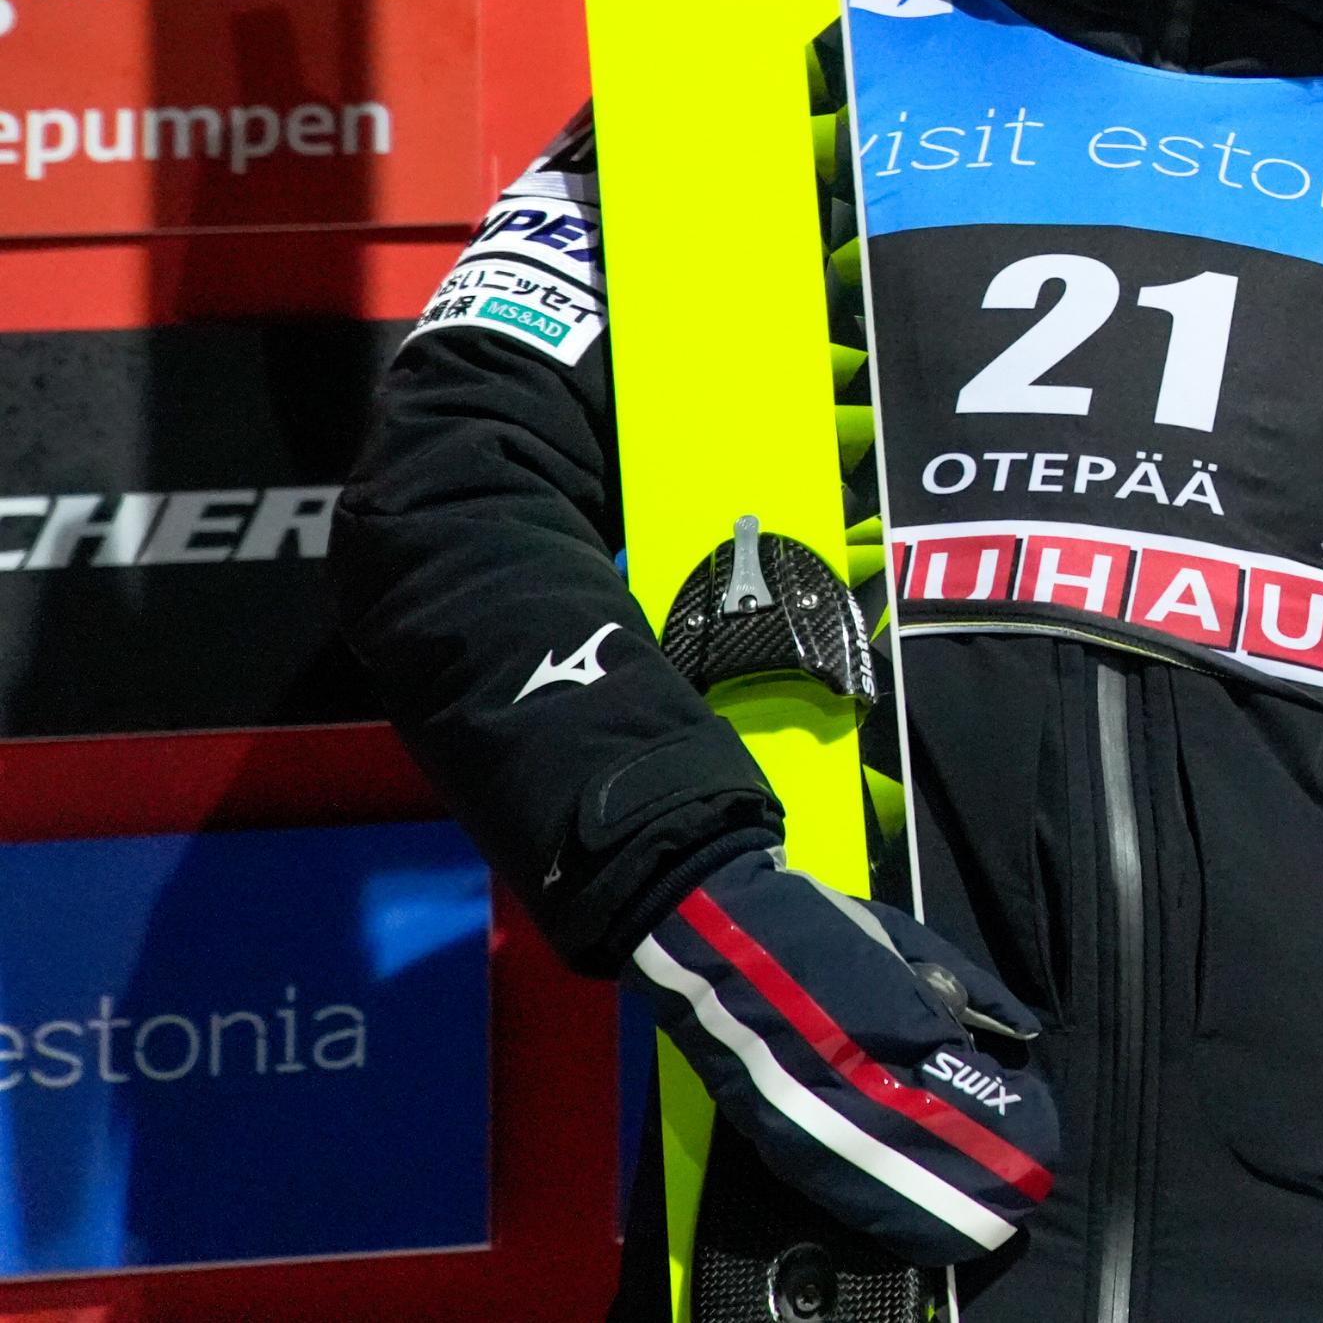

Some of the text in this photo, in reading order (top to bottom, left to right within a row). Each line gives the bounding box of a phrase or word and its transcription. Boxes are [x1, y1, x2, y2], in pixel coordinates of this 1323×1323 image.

[486, 302, 564, 339] MS&AD
[954, 253, 1240, 434] 21
[920, 450, 1225, 517] OTEPÄÄ
